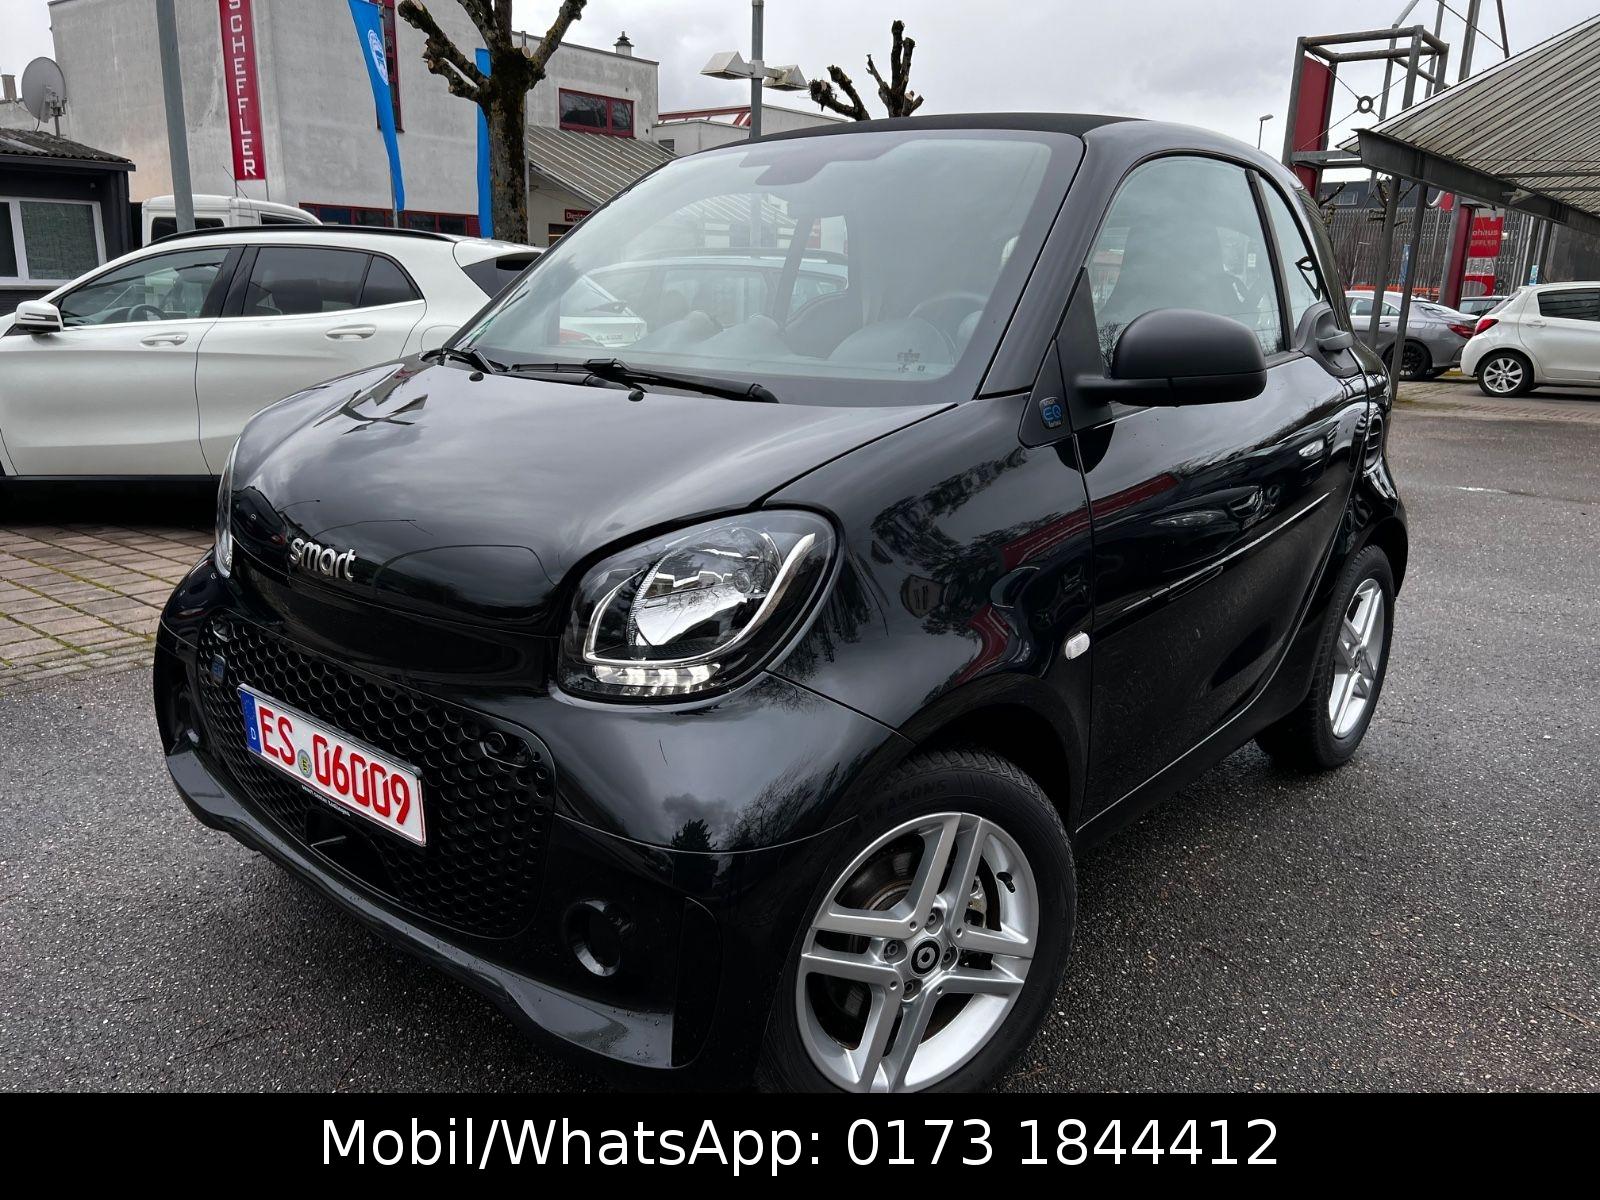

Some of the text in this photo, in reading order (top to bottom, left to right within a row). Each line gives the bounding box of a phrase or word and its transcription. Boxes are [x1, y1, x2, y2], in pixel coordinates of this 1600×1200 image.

[290, 537, 356, 582] smart
[259, 705, 297, 766] ES
[312, 733, 411, 826] 06009
